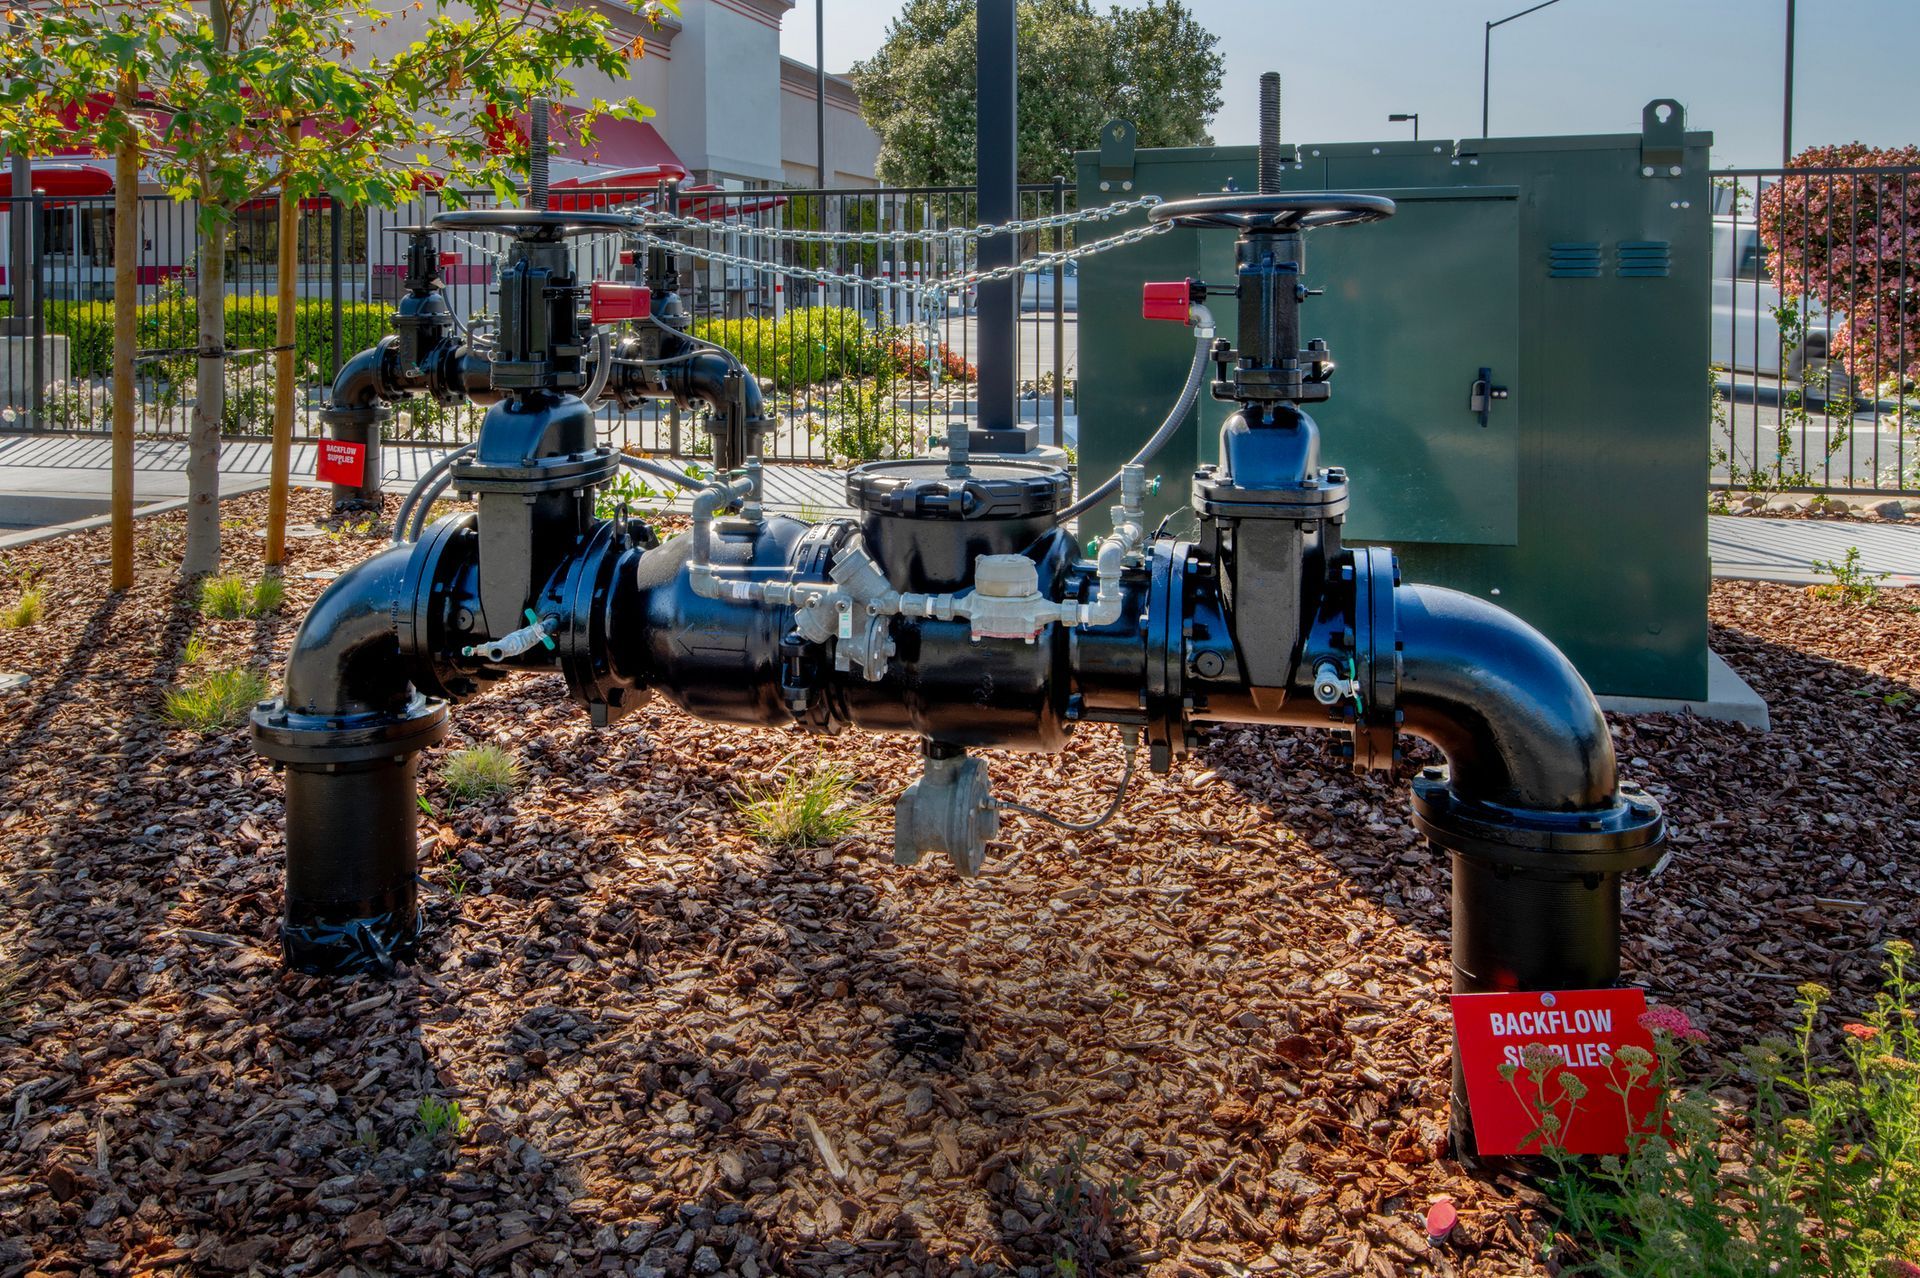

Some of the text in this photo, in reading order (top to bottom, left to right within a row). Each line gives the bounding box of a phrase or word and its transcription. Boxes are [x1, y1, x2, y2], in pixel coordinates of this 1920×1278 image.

[326, 444, 357, 455] BACKFLOW
[327, 453, 354, 464] SUPPLIES
[1489, 1009, 1612, 1036] BACKFLOW
[1503, 1043, 1610, 1067] SLIES
